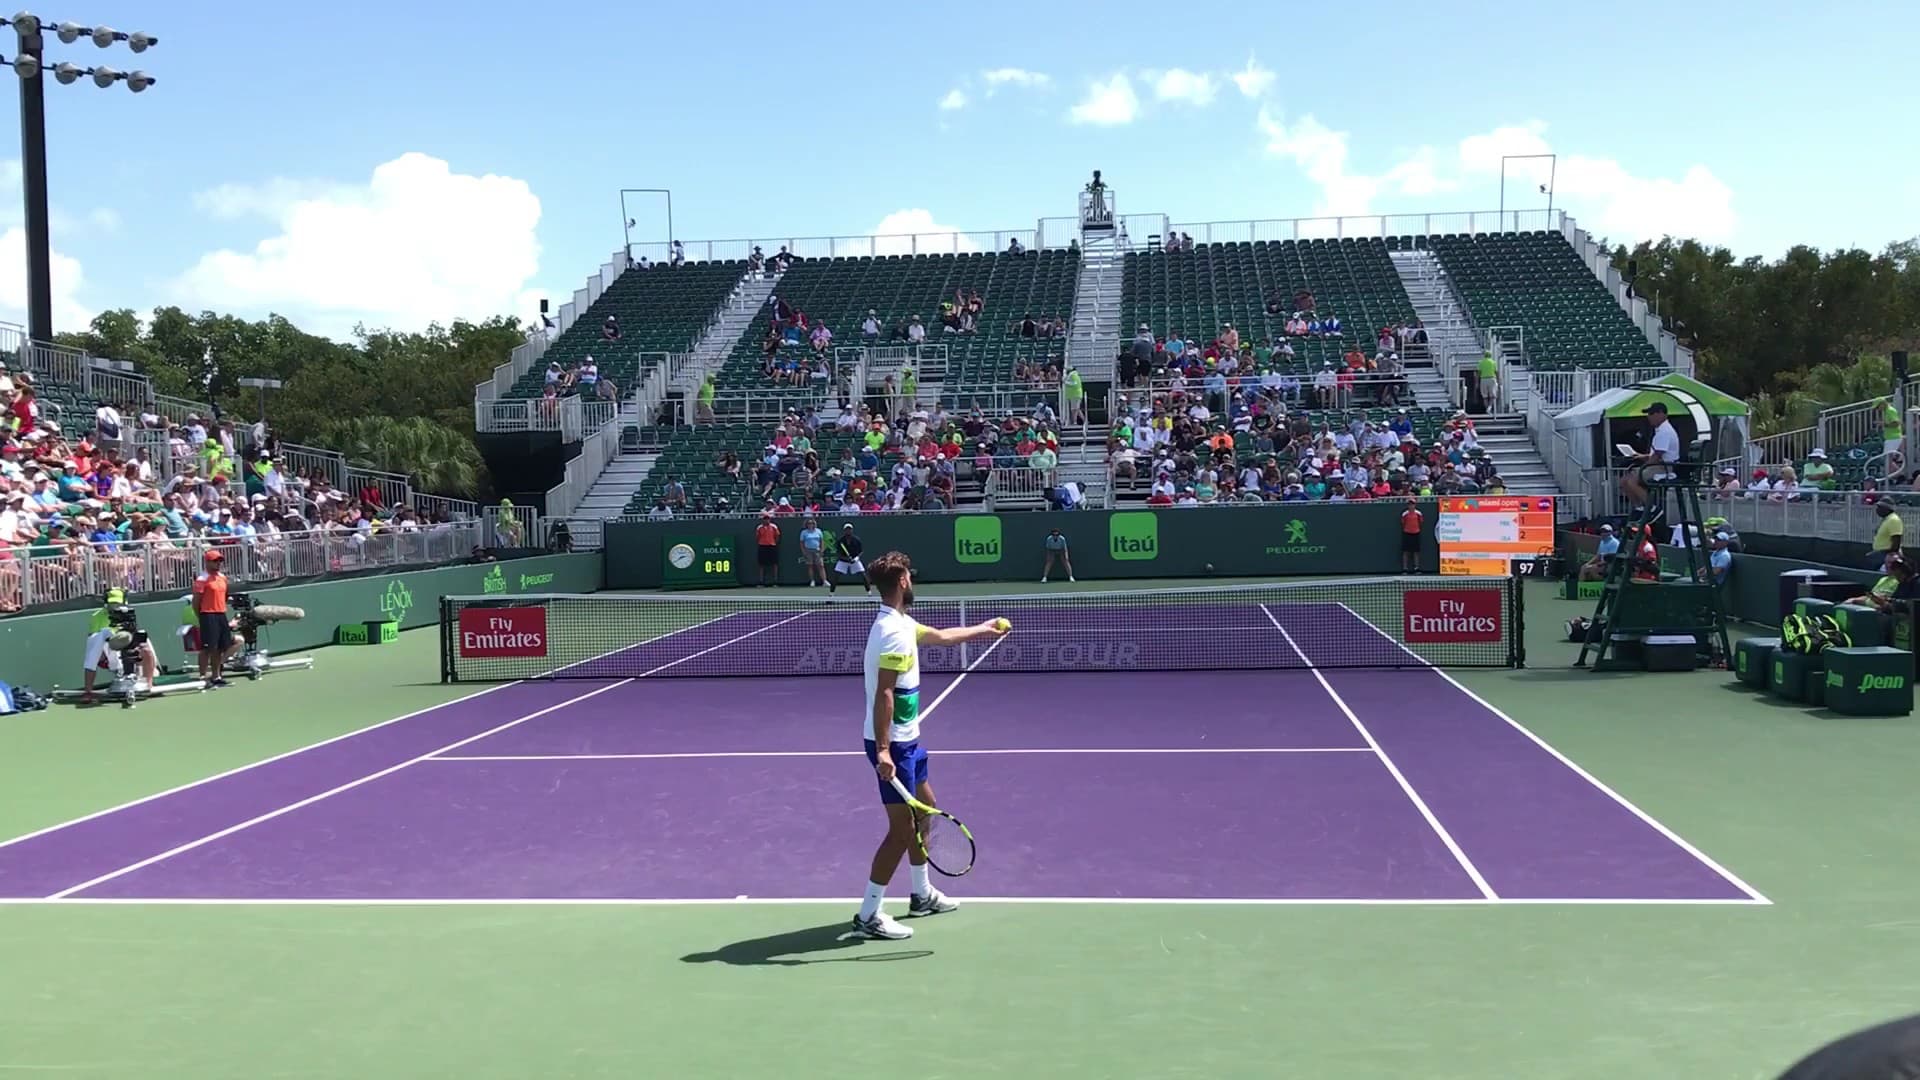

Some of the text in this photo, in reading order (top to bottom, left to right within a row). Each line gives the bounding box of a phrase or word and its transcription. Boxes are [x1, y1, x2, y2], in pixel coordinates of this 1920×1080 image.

[1478, 498, 1519, 508] miami open
[1520, 516, 1526, 525] 1
[1519, 531, 1526, 539] 2
[958, 538, 999, 556] Itaú
[1113, 535, 1155, 553] Itaú
[1265, 545, 1328, 555] PEUGEOT
[704, 560, 730, 573] 0:08
[1519, 562, 1535, 574] 97
[380, 590, 414, 613] LENOX
[1439, 599, 1465, 616] Fly
[489, 617, 513, 632] Fly
[1409, 613, 1496, 633] Emirates
[341, 630, 366, 642] Itaú
[463, 630, 542, 649] Emirates
[1037, 641, 1140, 667] TOUR
